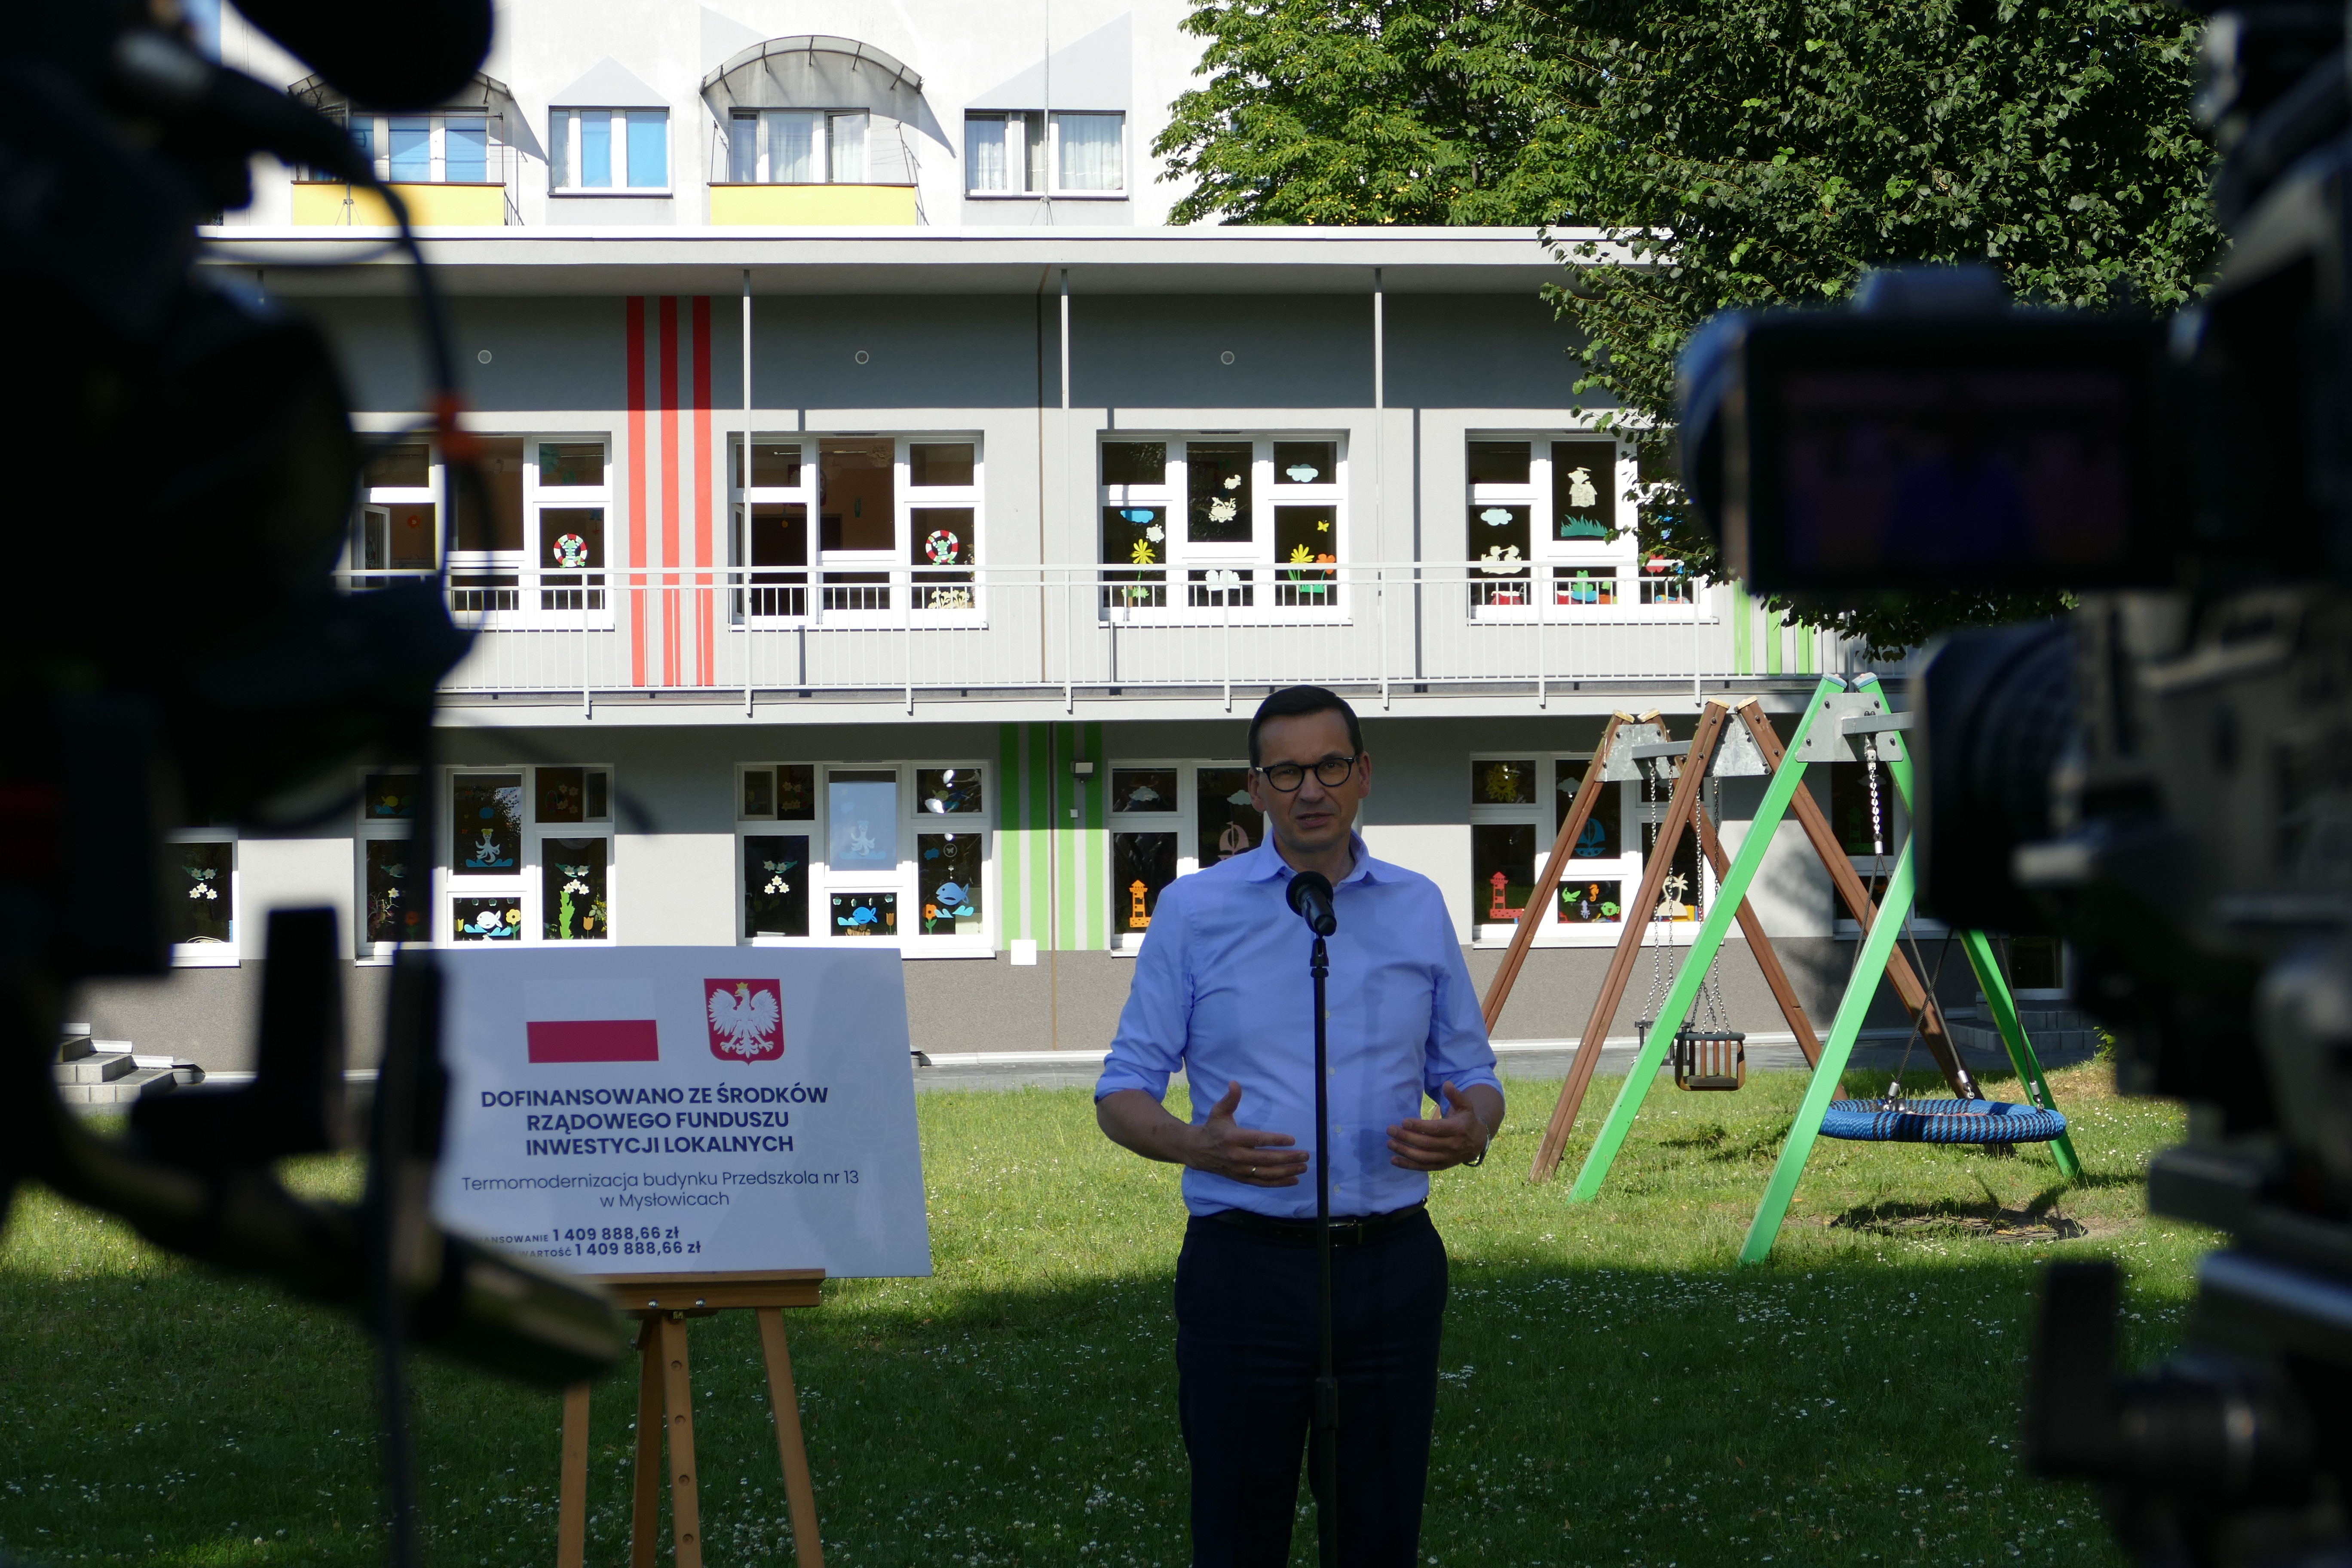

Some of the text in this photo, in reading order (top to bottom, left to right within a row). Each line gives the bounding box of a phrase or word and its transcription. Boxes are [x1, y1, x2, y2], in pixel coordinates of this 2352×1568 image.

[481, 1081, 828, 1107] DOFINANSOWANO ZE ŚRODKÓW
[527, 1112, 788, 1135] RZĄDOWEGO FUNDUSZU
[526, 1136, 793, 1156] INWESTYCJI LOKALNYCH
[462, 1170, 859, 1191] Termomodernizacja budynku Przedszkola nr 13
[600, 1192, 729, 1211] w Mysłowicach
[553, 1229, 559, 1242] 1
[564, 1228, 597, 1241] 409
[601, 1226, 661, 1242] 888,66
[665, 1226, 680, 1239] zł
[575, 1243, 581, 1256] 1
[587, 1242, 619, 1256] 409
[624, 1240, 683, 1256] 888,66
[687, 1240, 701, 1254] zł
